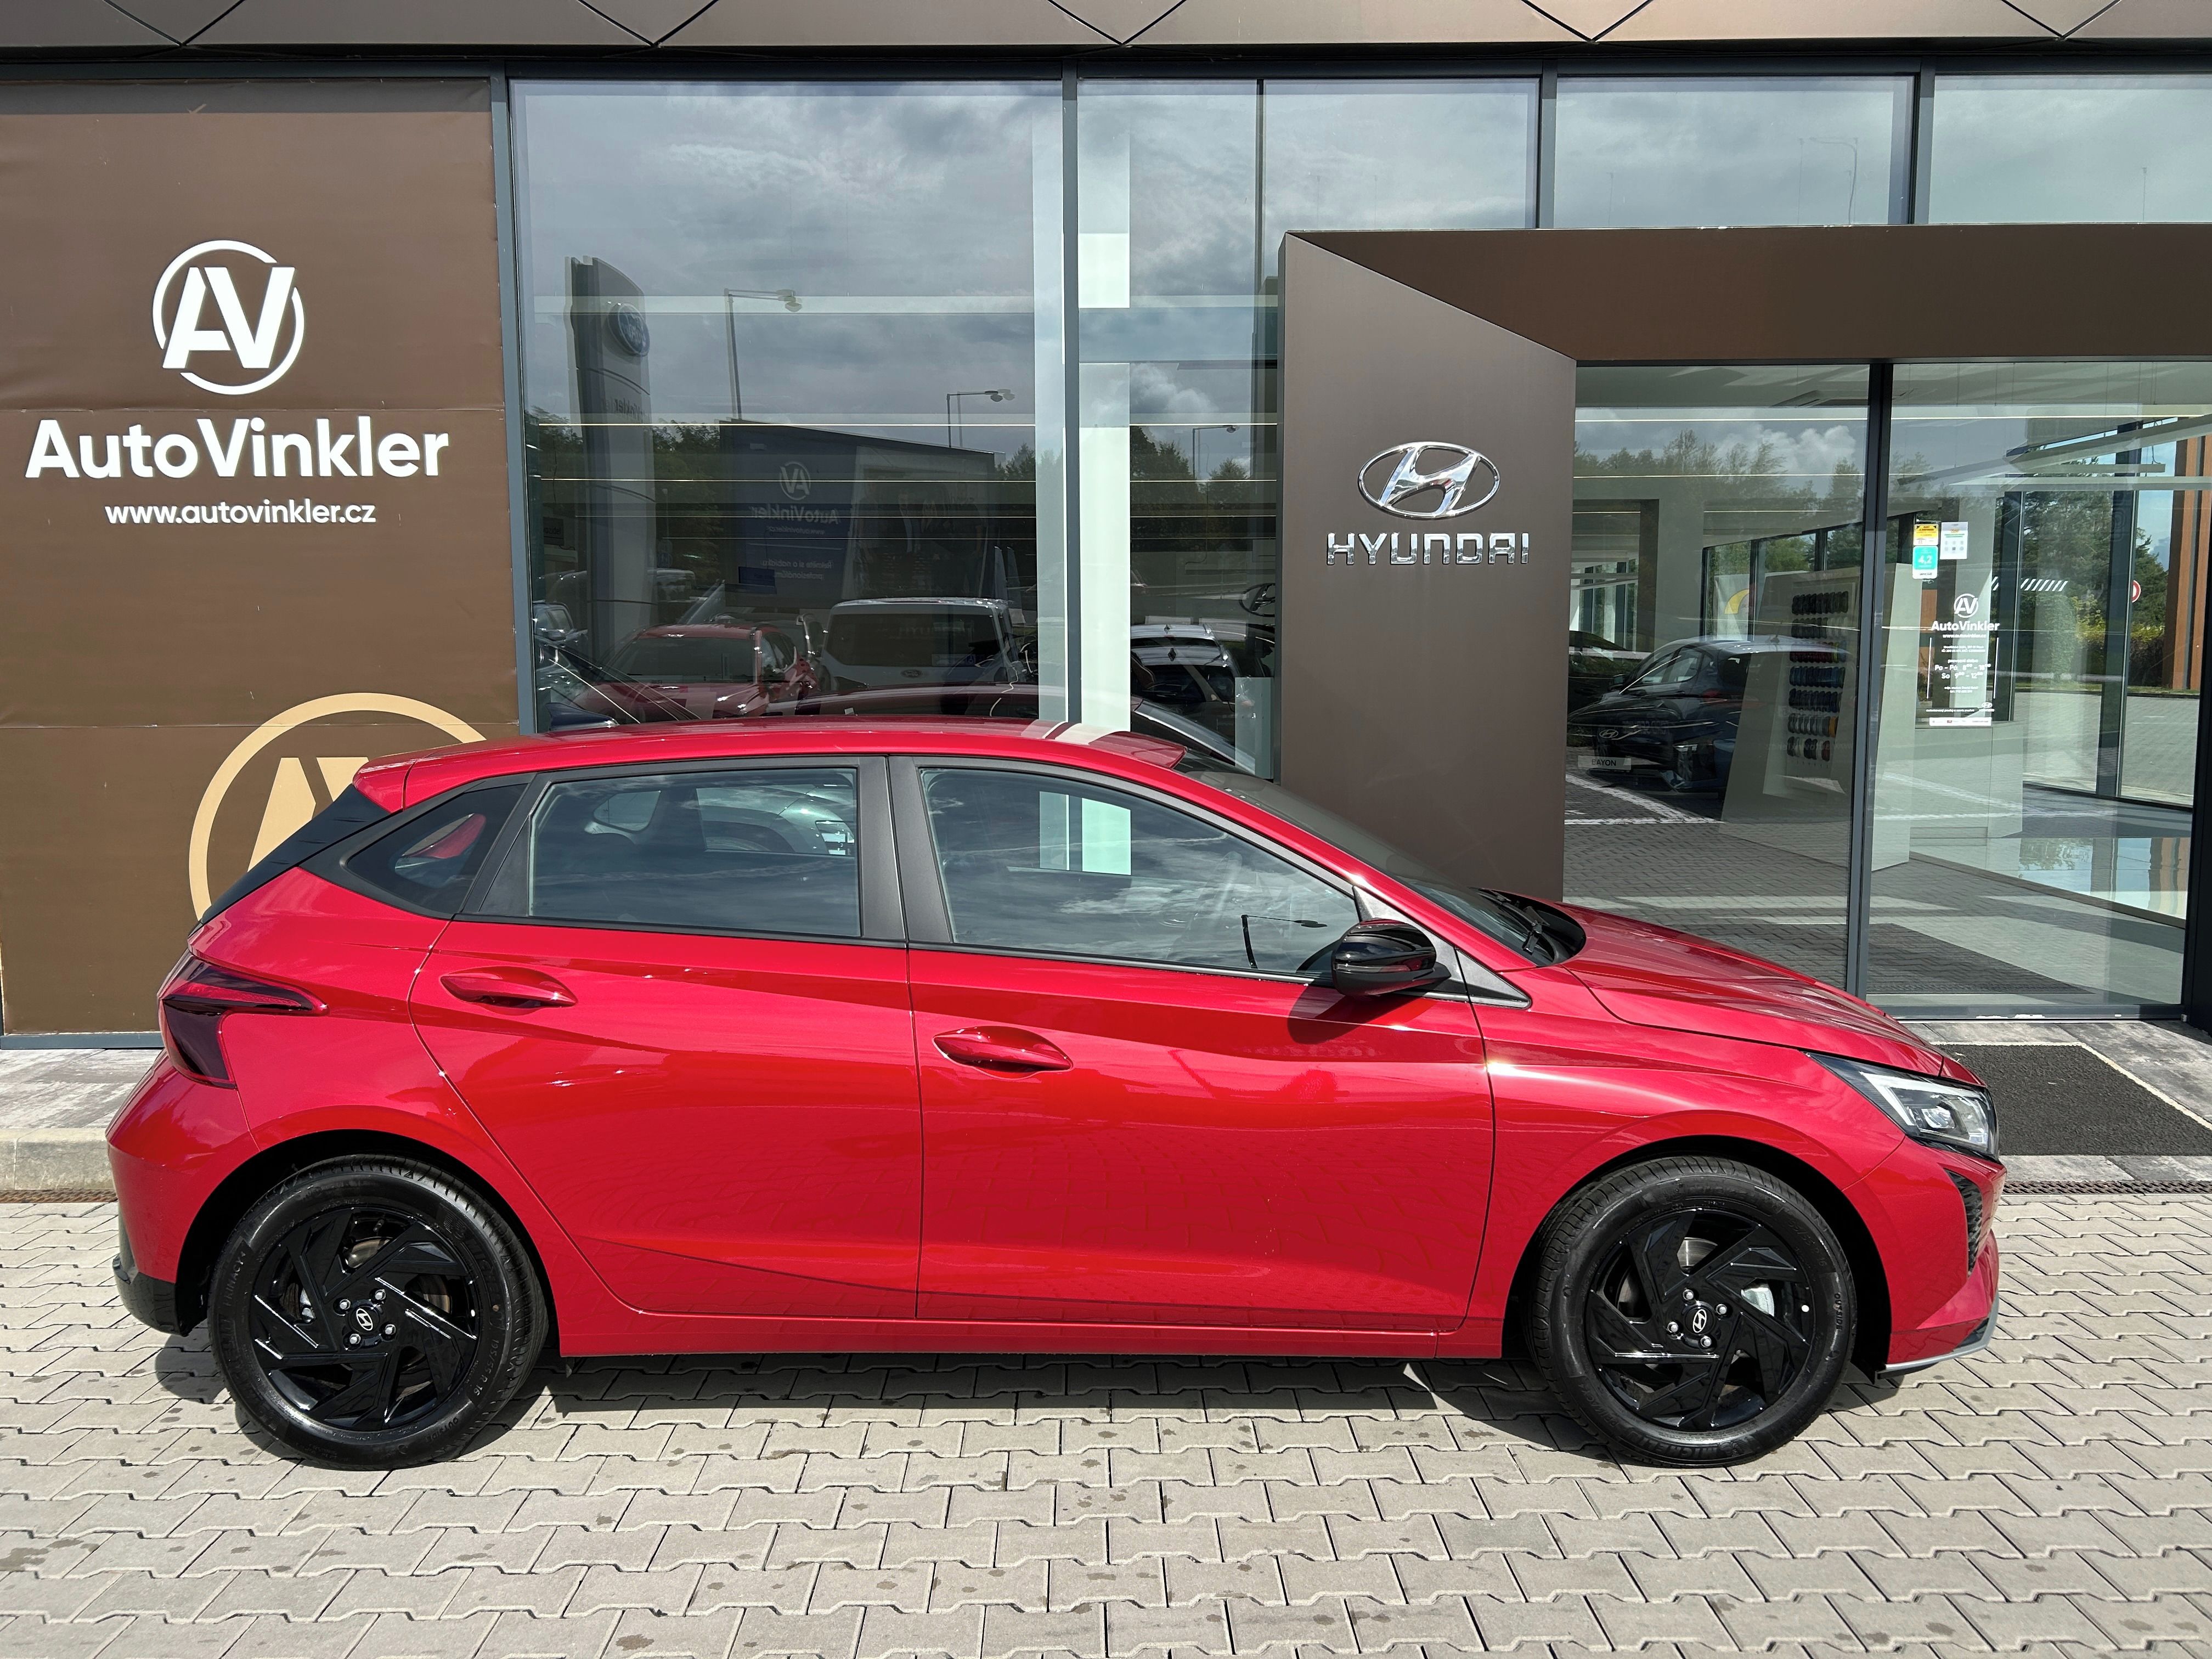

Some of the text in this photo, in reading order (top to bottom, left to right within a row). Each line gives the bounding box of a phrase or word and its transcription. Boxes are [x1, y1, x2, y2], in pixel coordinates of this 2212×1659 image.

[162, 267, 295, 369] AV
[25, 416, 449, 478] AutoVinkler
[104, 499, 376, 524] www.autovinkler.cz
[1327, 532, 1530, 565] HYUNDAI
[1954, 597, 1978, 614] AV
[1931, 620, 2000, 631] AutoVinkler
[473, 1339, 500, 1396] 195/55 R 16
[1581, 1390, 1620, 1427] PRIMACY
